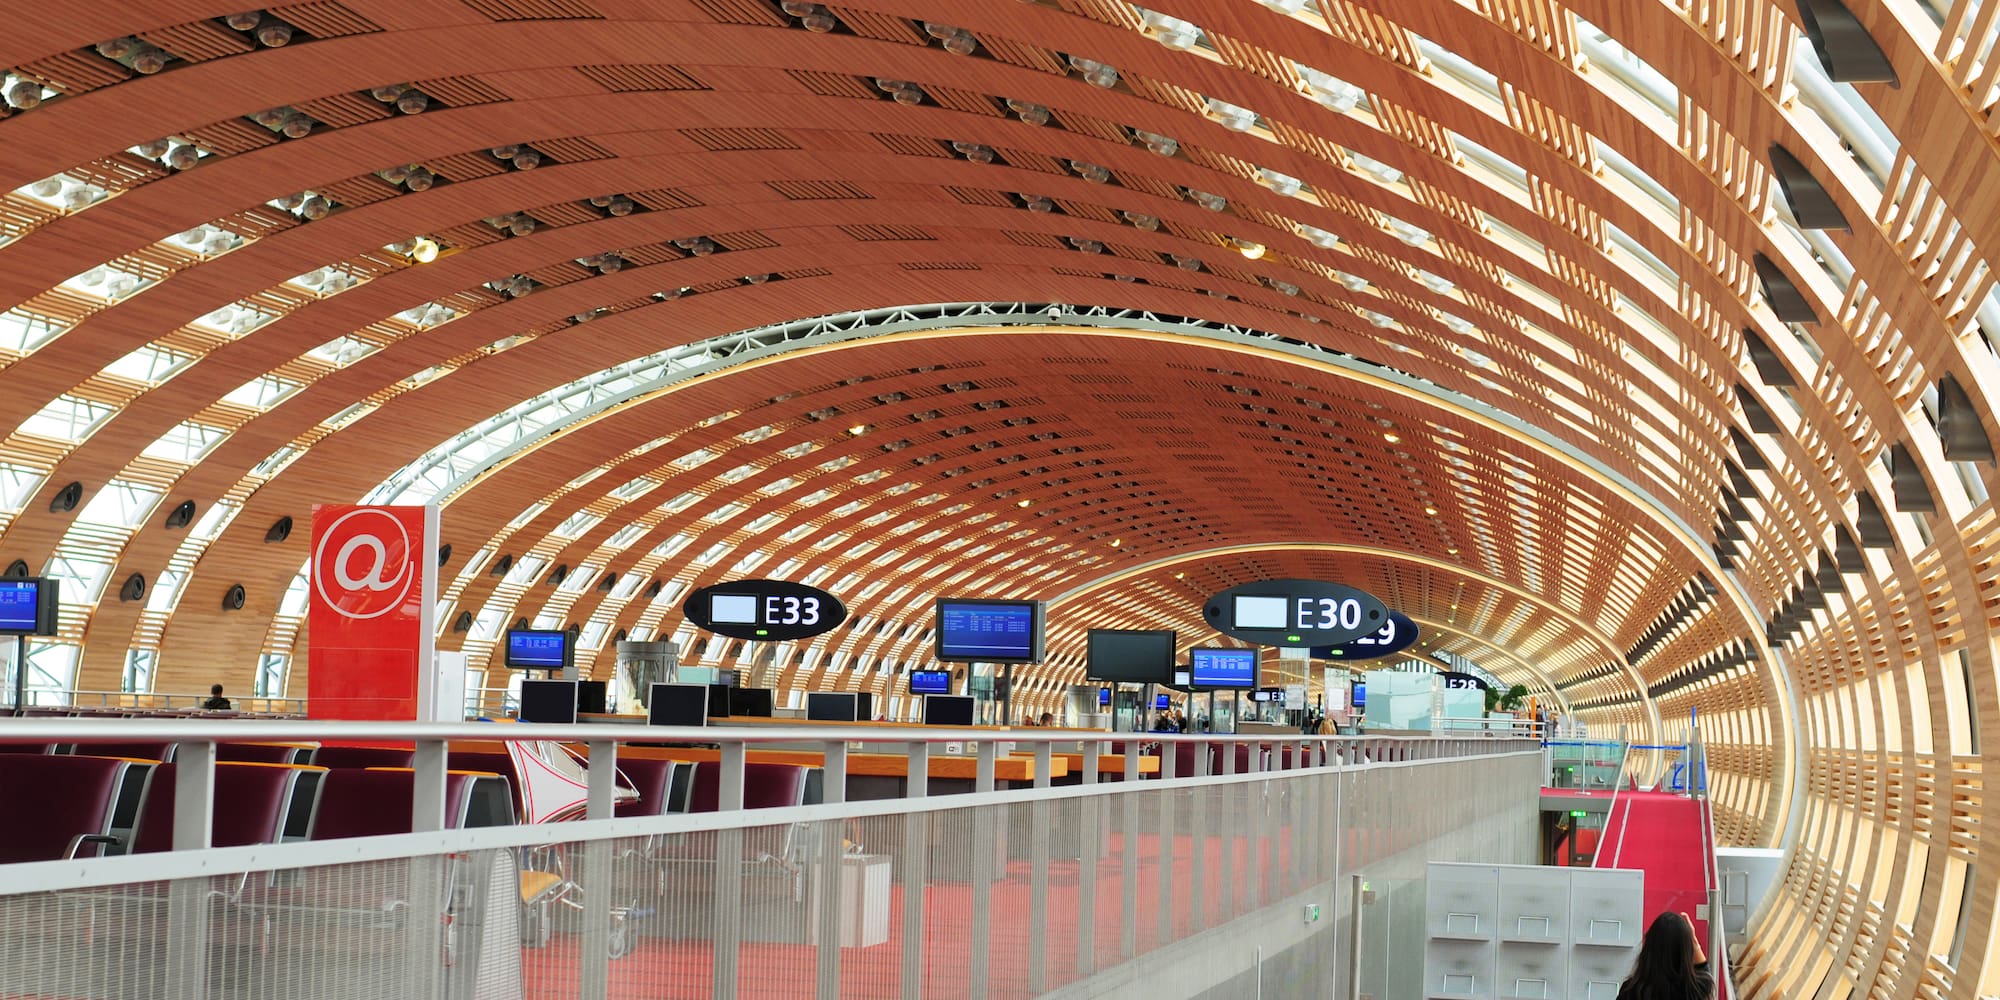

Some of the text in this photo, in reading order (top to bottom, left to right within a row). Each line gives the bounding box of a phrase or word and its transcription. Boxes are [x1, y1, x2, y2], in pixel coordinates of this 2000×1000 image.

[315, 508, 415, 619] @
[765, 596, 820, 625] E33
[1297, 598, 1362, 630] E30
[1271, 691, 1287, 702] E3
